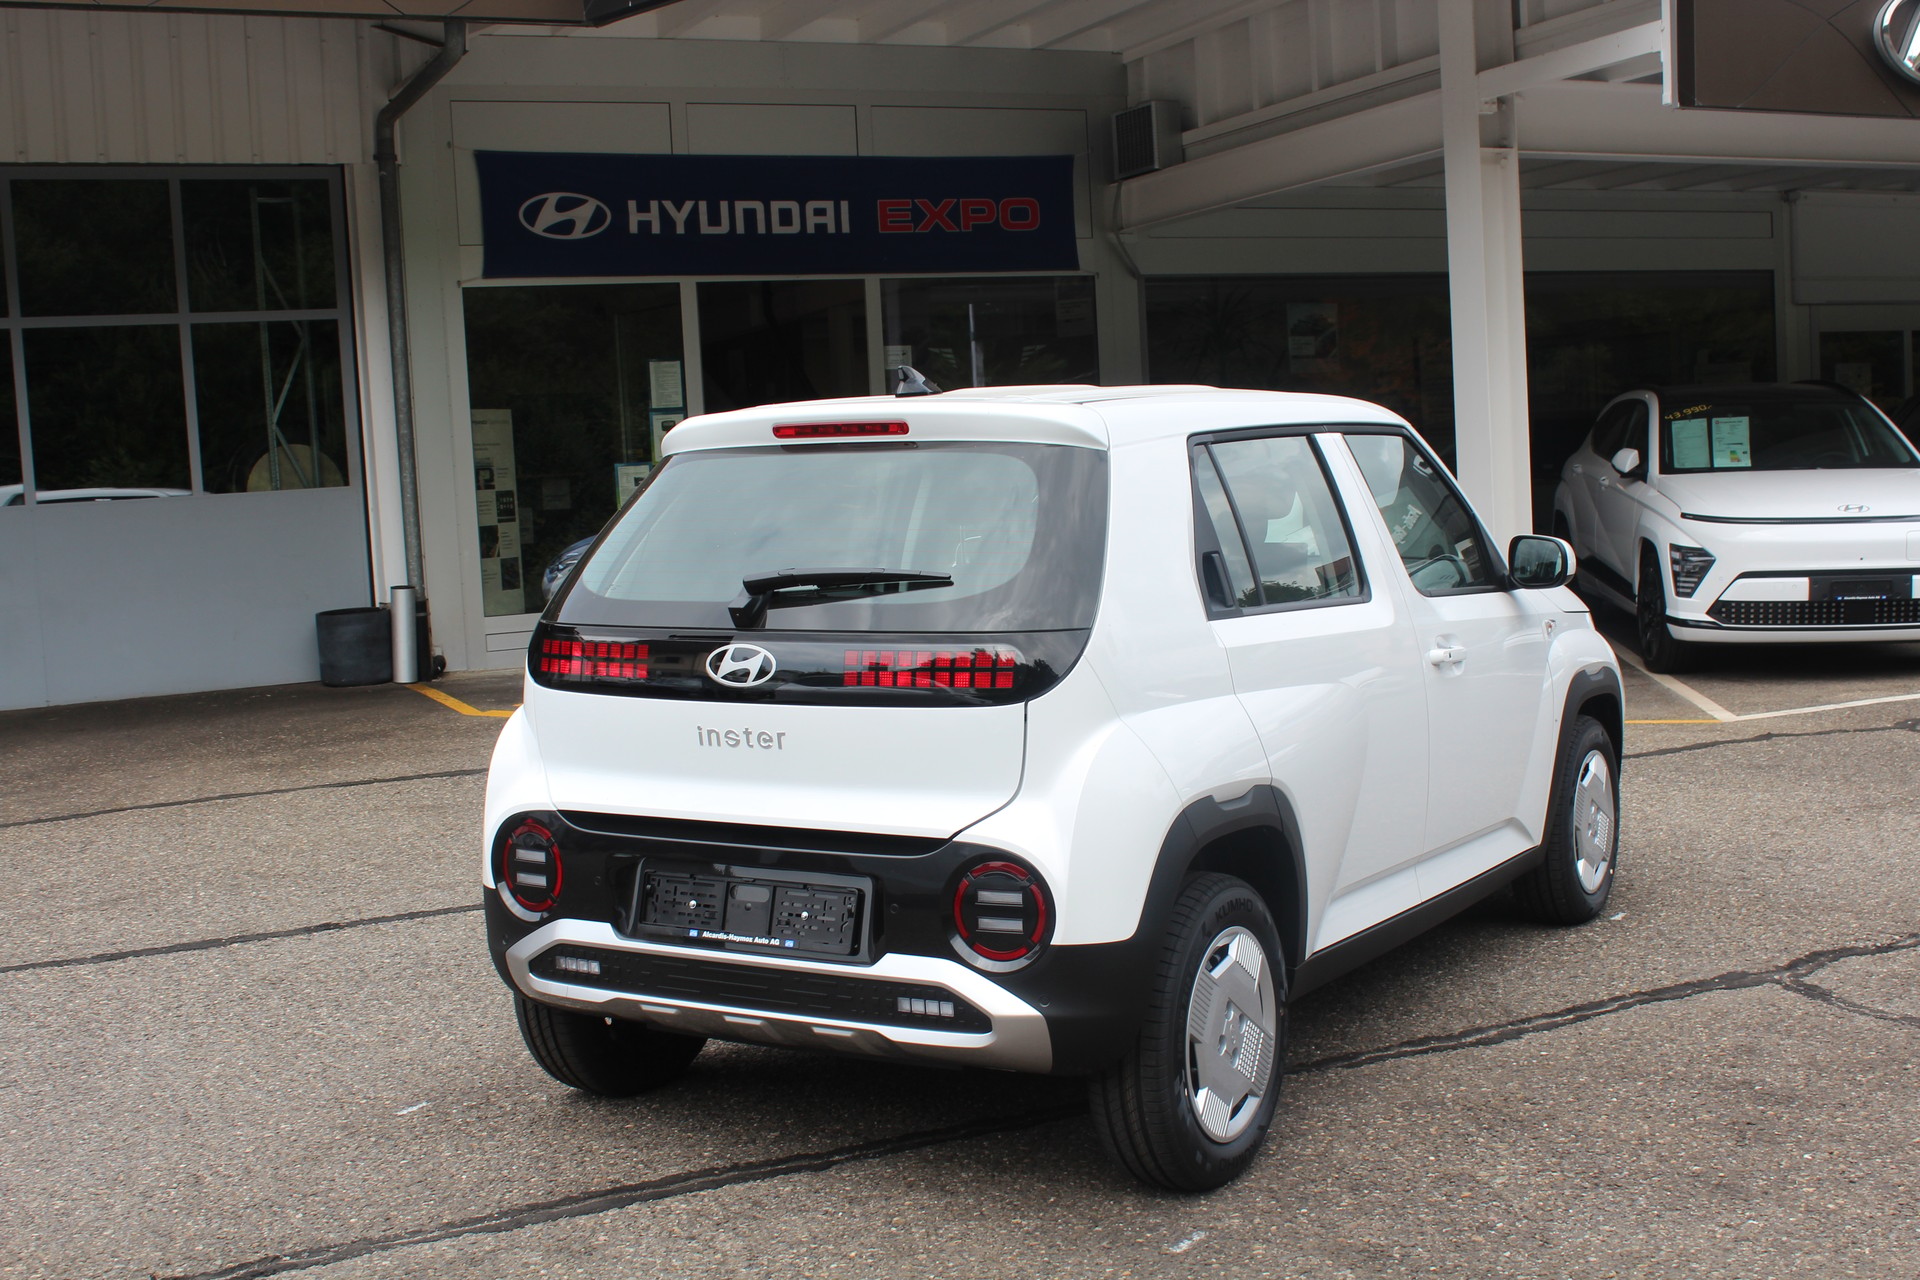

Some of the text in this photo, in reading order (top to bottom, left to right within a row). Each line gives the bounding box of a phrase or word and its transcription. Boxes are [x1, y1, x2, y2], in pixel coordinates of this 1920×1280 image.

[627, 196, 1041, 234] HYUNDAI EXPO
[696, 725, 786, 750] inster
[1215, 897, 1253, 921] KUMHO
[702, 931, 780, 946] Alcardis-Haymoz Auto AG
